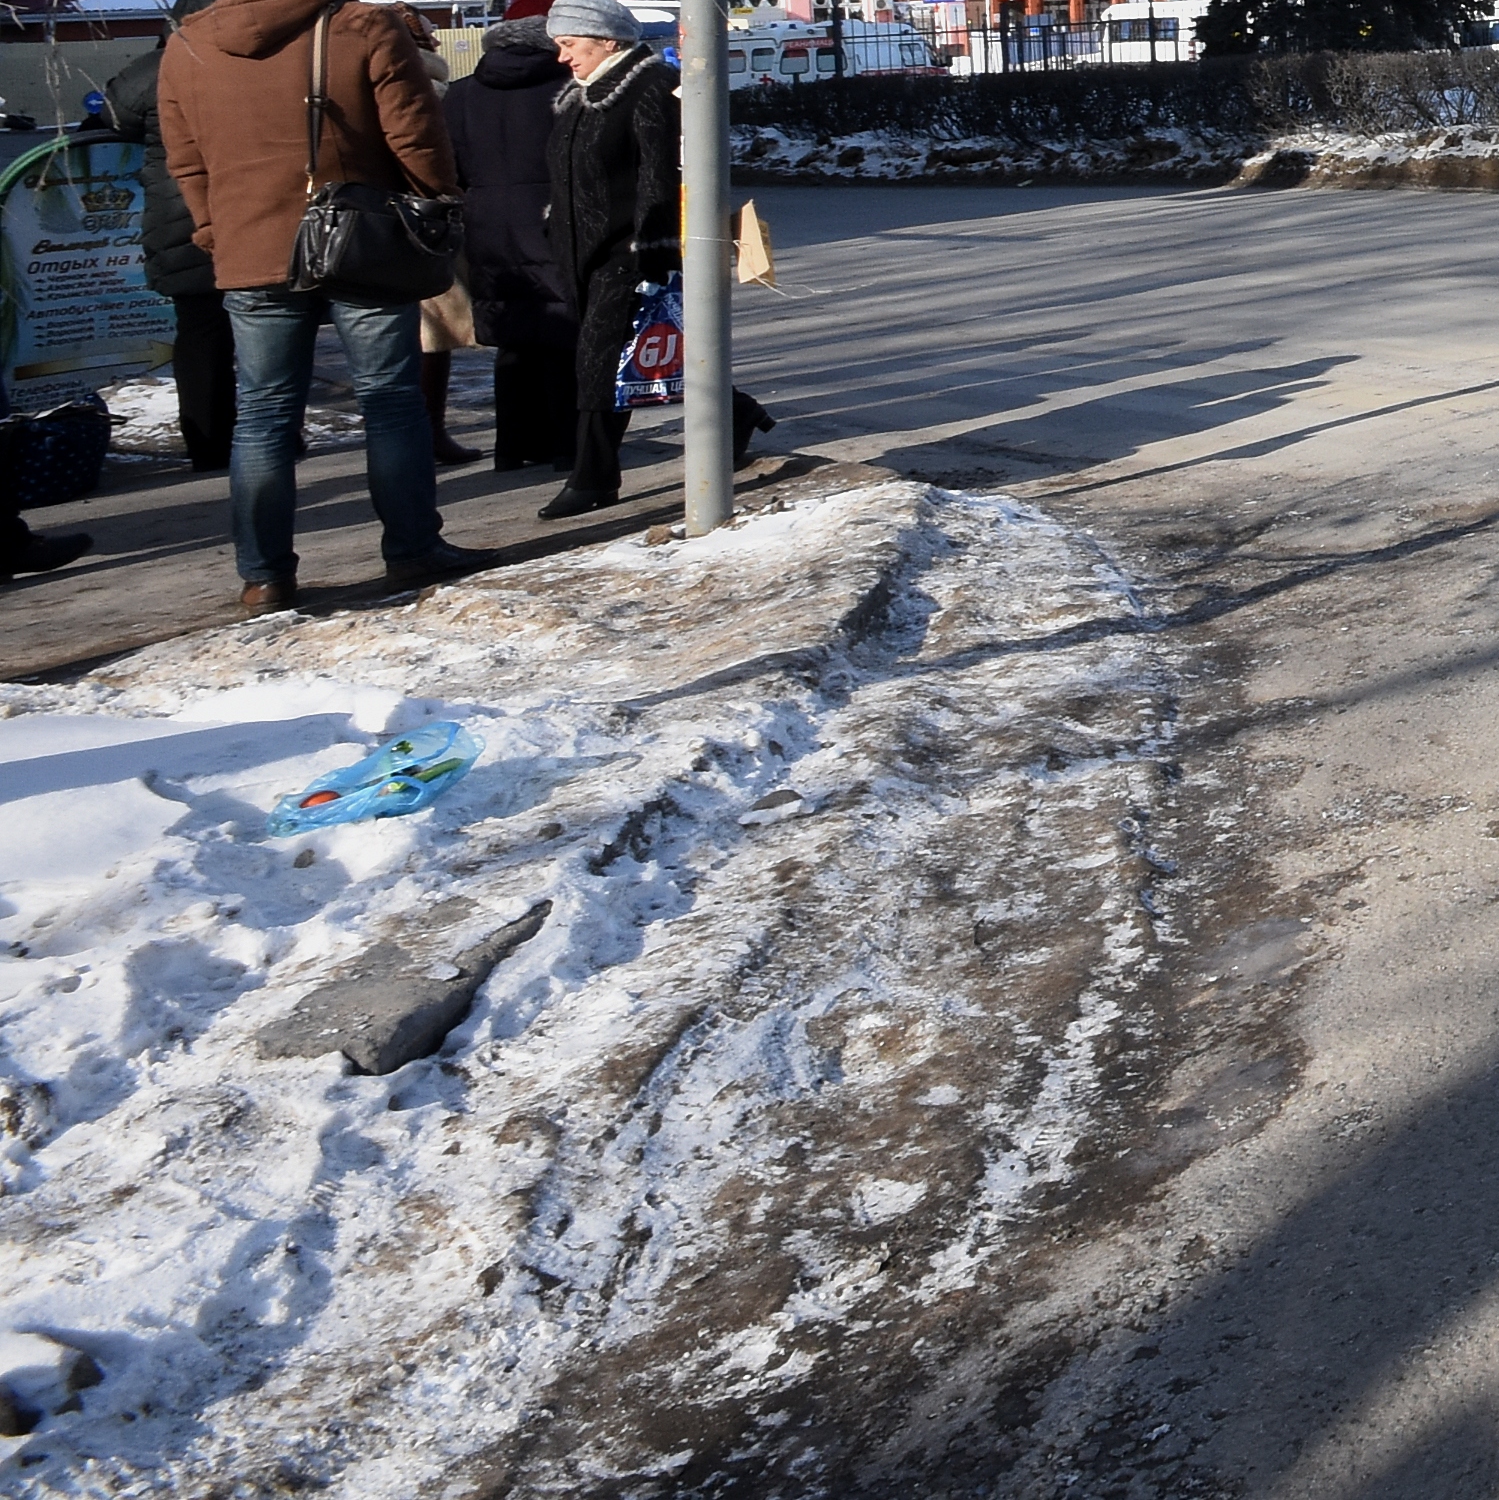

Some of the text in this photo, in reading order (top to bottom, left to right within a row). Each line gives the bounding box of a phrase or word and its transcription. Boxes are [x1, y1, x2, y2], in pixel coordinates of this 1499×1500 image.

[27, 257, 99, 275] Отдых
[105, 254, 131, 267] на
[26, 301, 125, 320] Автобусные
[638, 334, 678, 368] GJ
